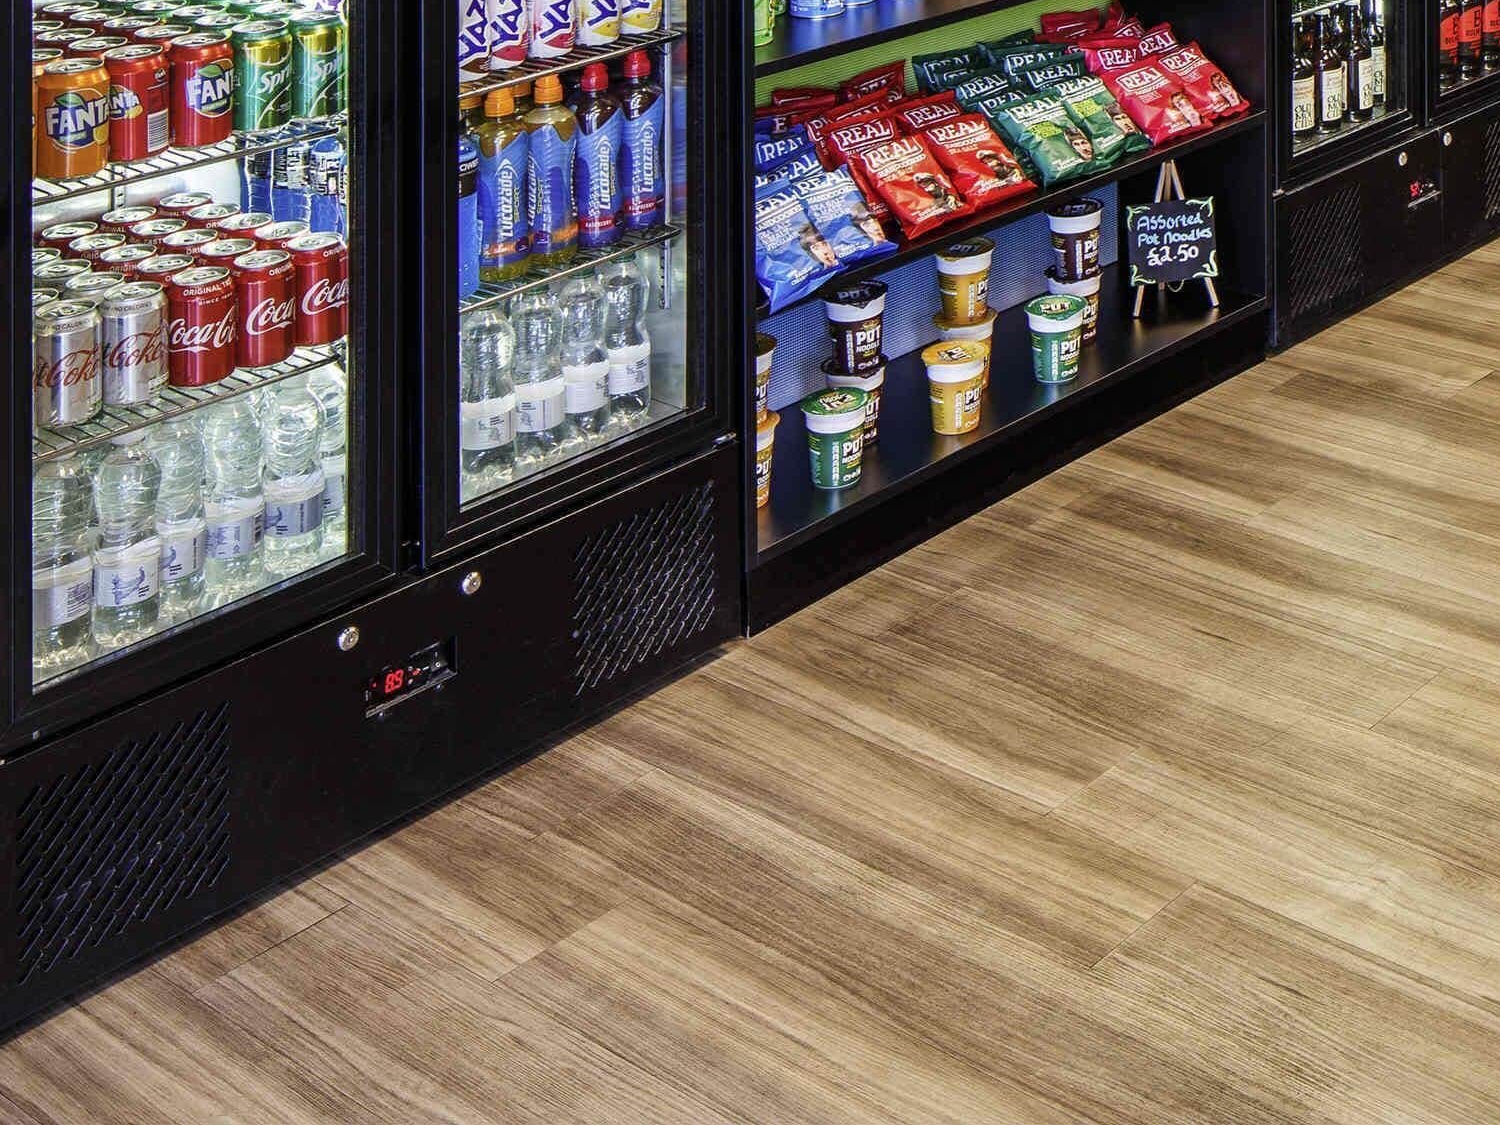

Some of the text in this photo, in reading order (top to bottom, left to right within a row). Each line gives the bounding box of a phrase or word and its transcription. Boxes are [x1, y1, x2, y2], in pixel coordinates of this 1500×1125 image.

[1163, 49, 1196, 71] REA
[257, 67, 292, 95] Spri
[963, 74, 1008, 99] REAL
[911, 103, 956, 124] REAL
[1012, 95, 1059, 119] REAL
[838, 120, 892, 147] REAL
[931, 119, 985, 143] REAL
[640, 130, 654, 194] Lucozade
[866, 138, 919, 168] REAL
[597, 145, 611, 211] Lucozade
[500, 165, 514, 238] Lucozade
[755, 186, 798, 214] EAL
[1136, 212, 1205, 231] Assorted
[1137, 232, 1161, 248] Pot
[1146, 243, 1200, 267] £2.50
[183, 282, 220, 296] ORIGINAL
[1040, 302, 1071, 313] POT
[855, 329, 881, 347] POT
[1060, 337, 1081, 355] POT
[842, 434, 864, 457] POT
